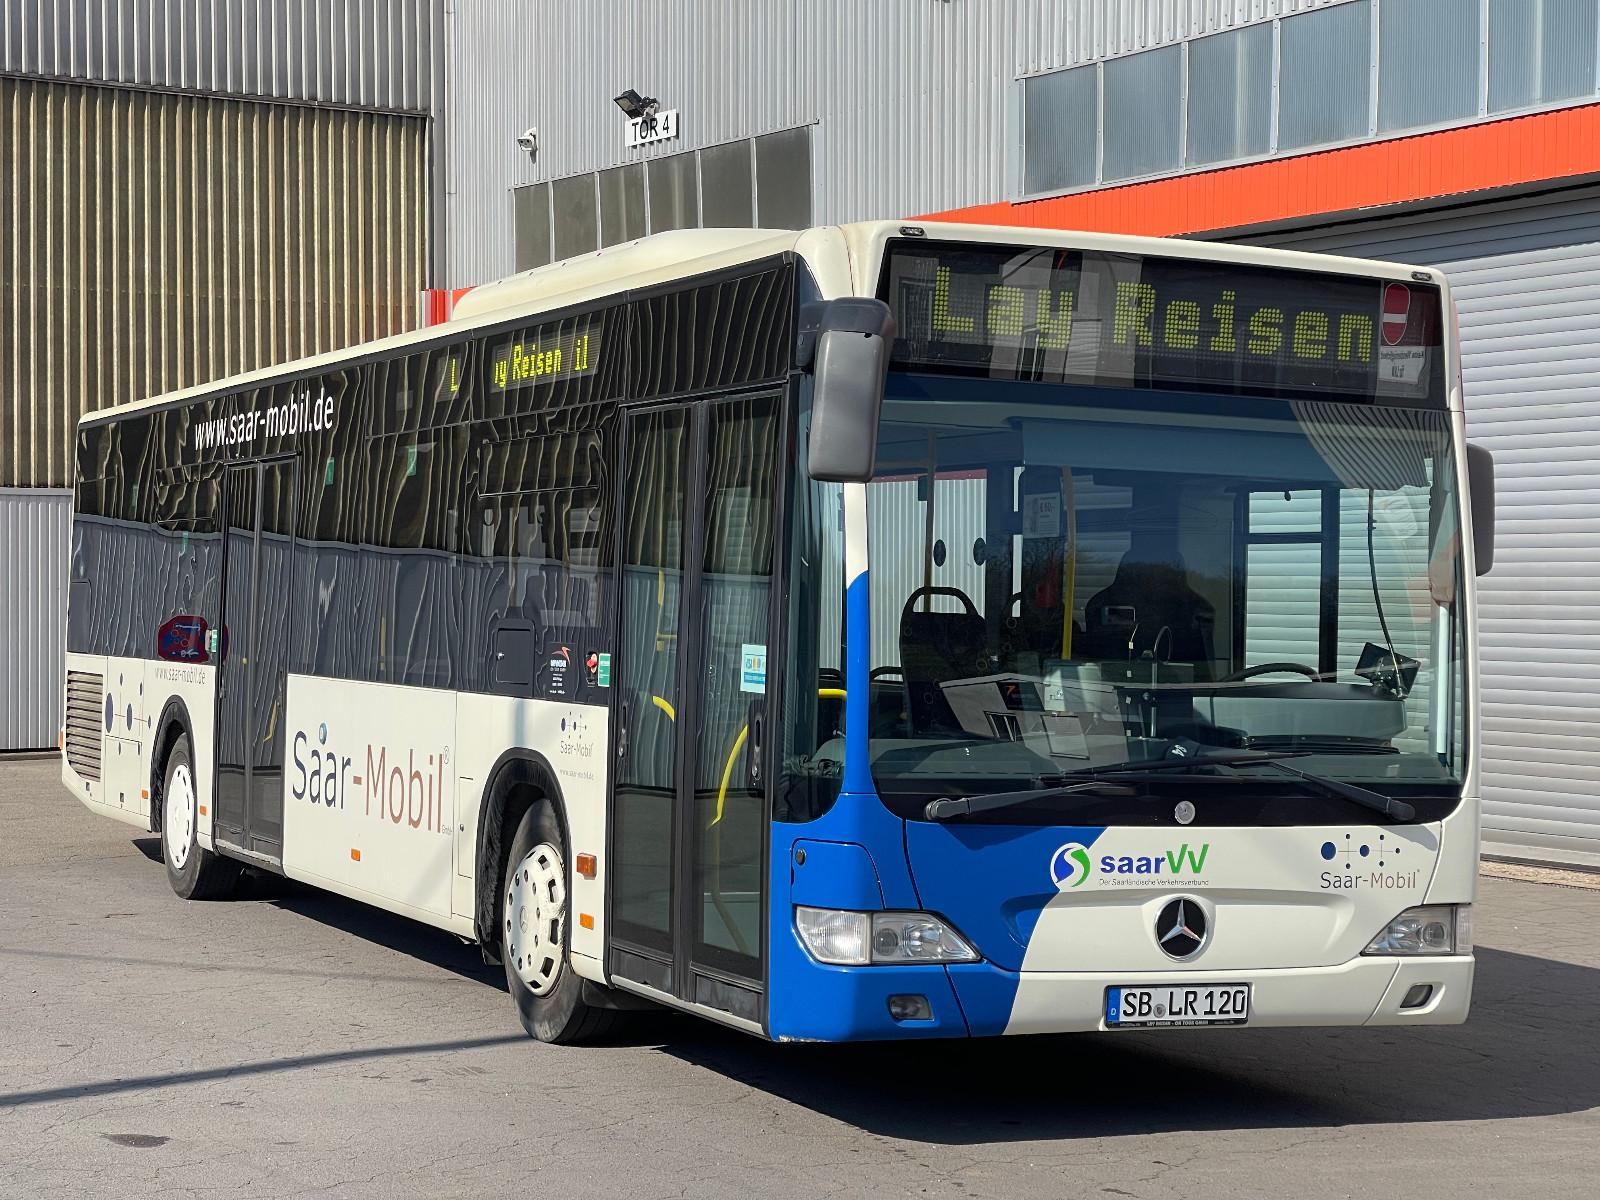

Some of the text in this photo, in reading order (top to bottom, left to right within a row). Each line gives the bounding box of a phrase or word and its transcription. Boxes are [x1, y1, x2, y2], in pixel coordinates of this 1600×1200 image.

[631, 114, 670, 141] TOR 4
[933, 266, 1373, 363] Lay Reisen
[512, 344, 562, 380] Reisen
[194, 387, 334, 451] www.saar-mobil.de
[1099, 878, 1110, 886] Der
[1156, 878, 1209, 886] Verkehrsverbund
[1122, 991, 1152, 1017] SB
[1168, 990, 1198, 1016] LR
[1203, 989, 1246, 1015] 120
